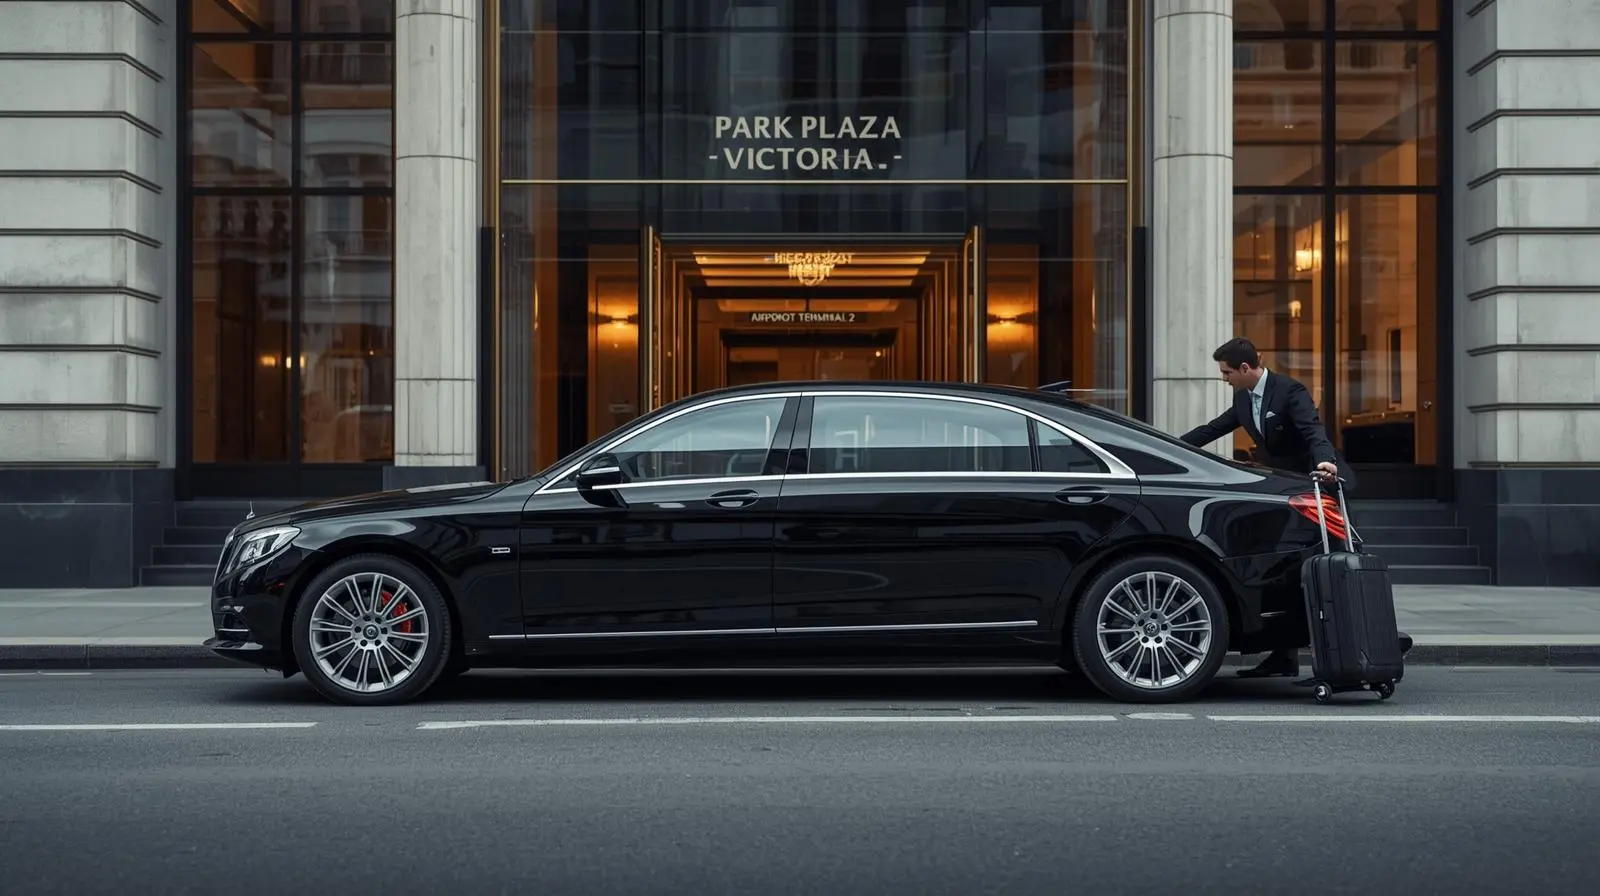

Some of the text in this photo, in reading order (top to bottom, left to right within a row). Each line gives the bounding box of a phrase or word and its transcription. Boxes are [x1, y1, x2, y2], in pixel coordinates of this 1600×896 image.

[715, 116, 902, 138] PARK PLAZA
[848, 312, 856, 322] 2
